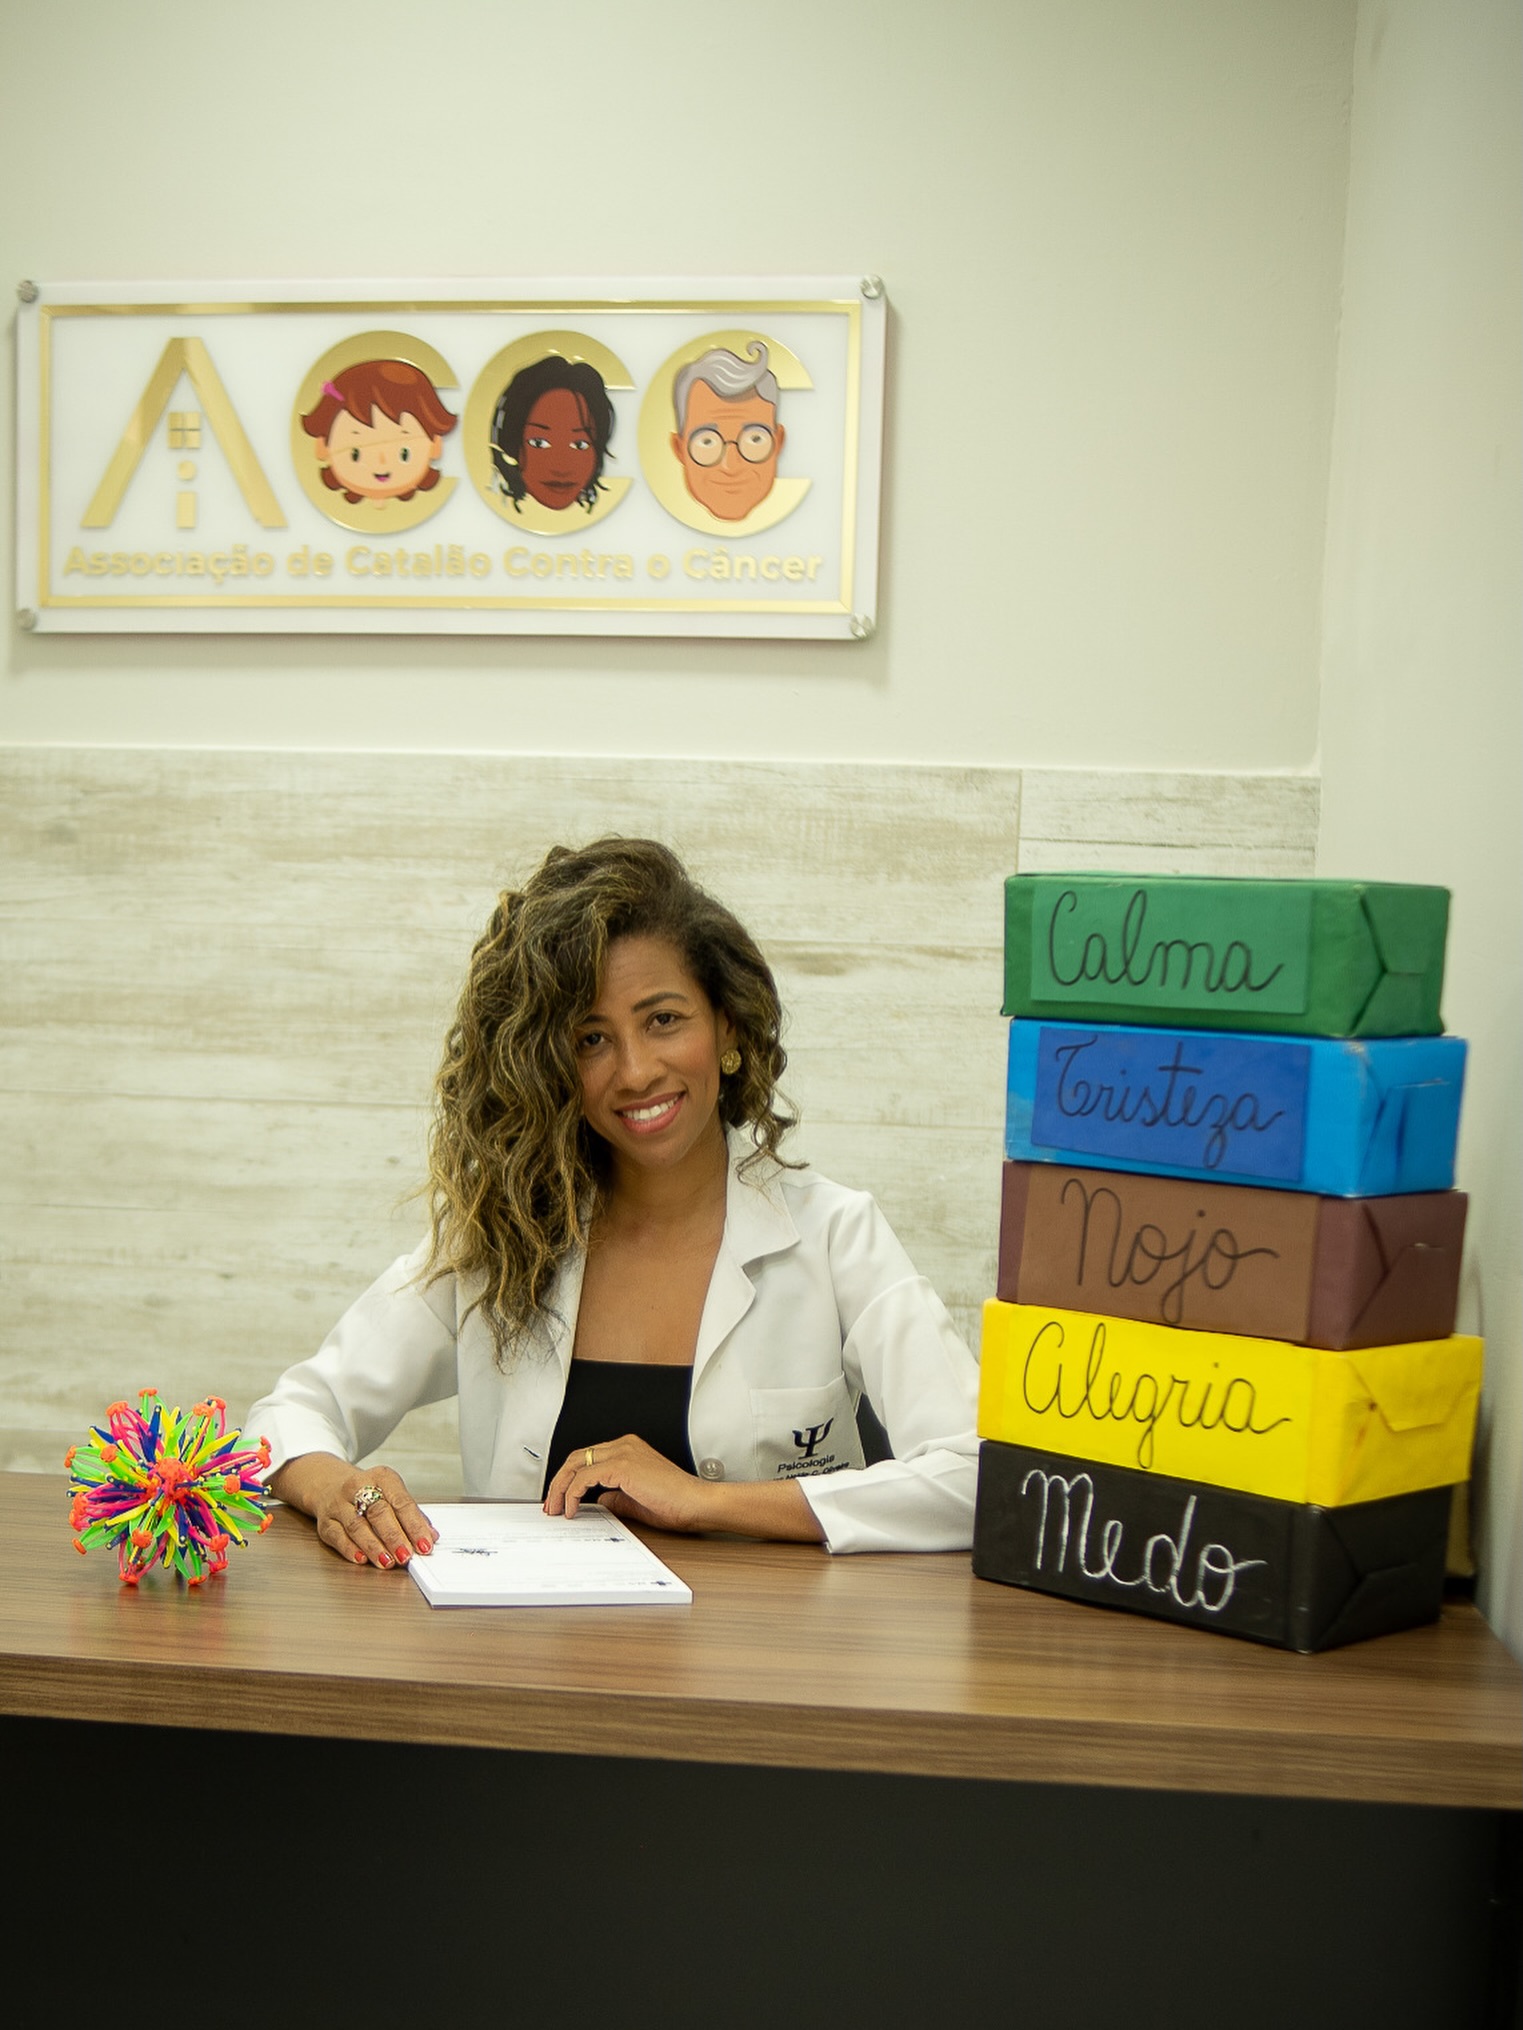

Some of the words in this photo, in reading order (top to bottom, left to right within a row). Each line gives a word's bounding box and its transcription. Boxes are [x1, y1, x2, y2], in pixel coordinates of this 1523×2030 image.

[63, 543, 276, 585] Associação
[286, 543, 334, 577] de
[345, 543, 493, 578] Catalão
[503, 545, 634, 580] Contra
[646, 552, 671, 580] o
[682, 544, 823, 581] Câncer
[1048, 888, 1285, 994] Calma
[1054, 1034, 1286, 1170] Tristeza
[1060, 1177, 1281, 1325] Nojo
[1022, 1320, 1293, 1470] Alegria
[778, 1455, 835, 1472] Psicologia
[1020, 1468, 1269, 1612] Medo
